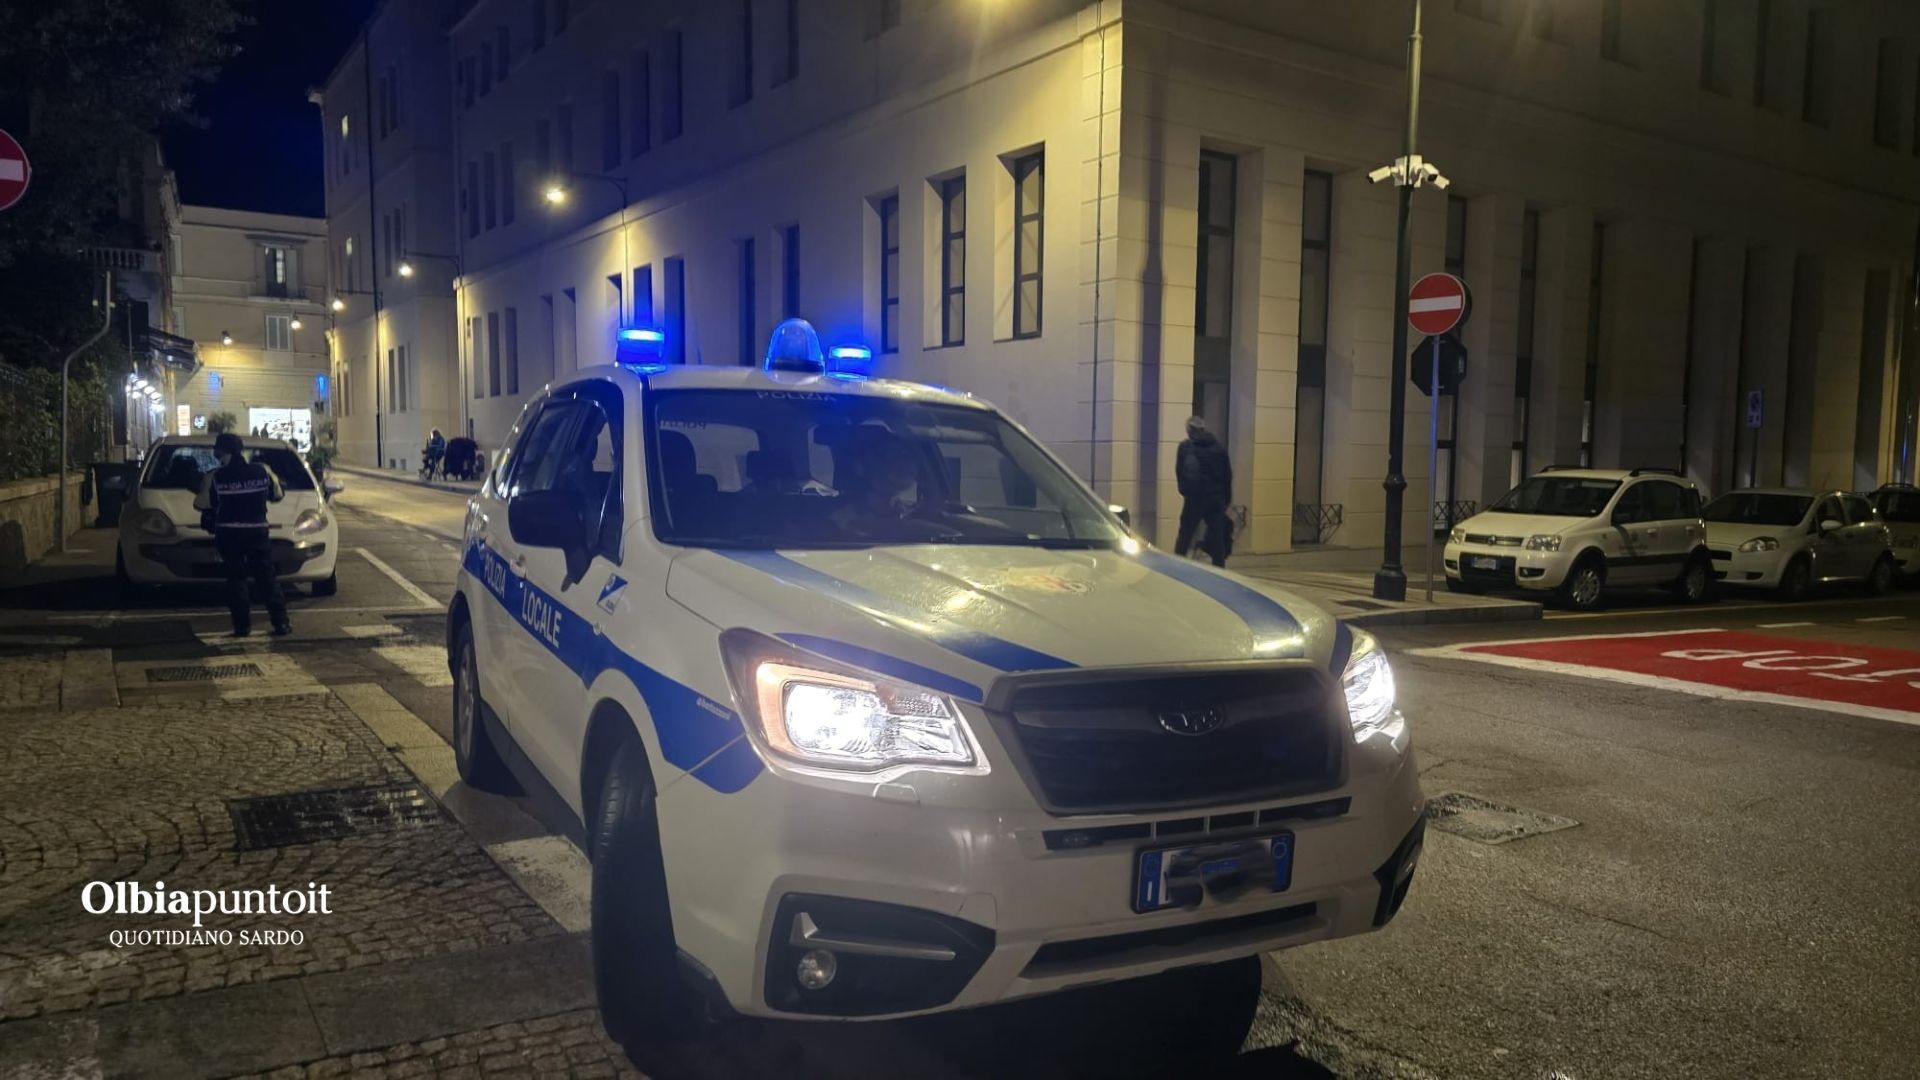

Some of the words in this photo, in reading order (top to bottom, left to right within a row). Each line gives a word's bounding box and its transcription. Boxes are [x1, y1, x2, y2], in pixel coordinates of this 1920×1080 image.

[756, 390, 837, 402] POLIZIA
[216, 480, 242, 490] IZIA
[521, 585, 562, 649] LOCALE
[1660, 648, 1920, 690] TOP
